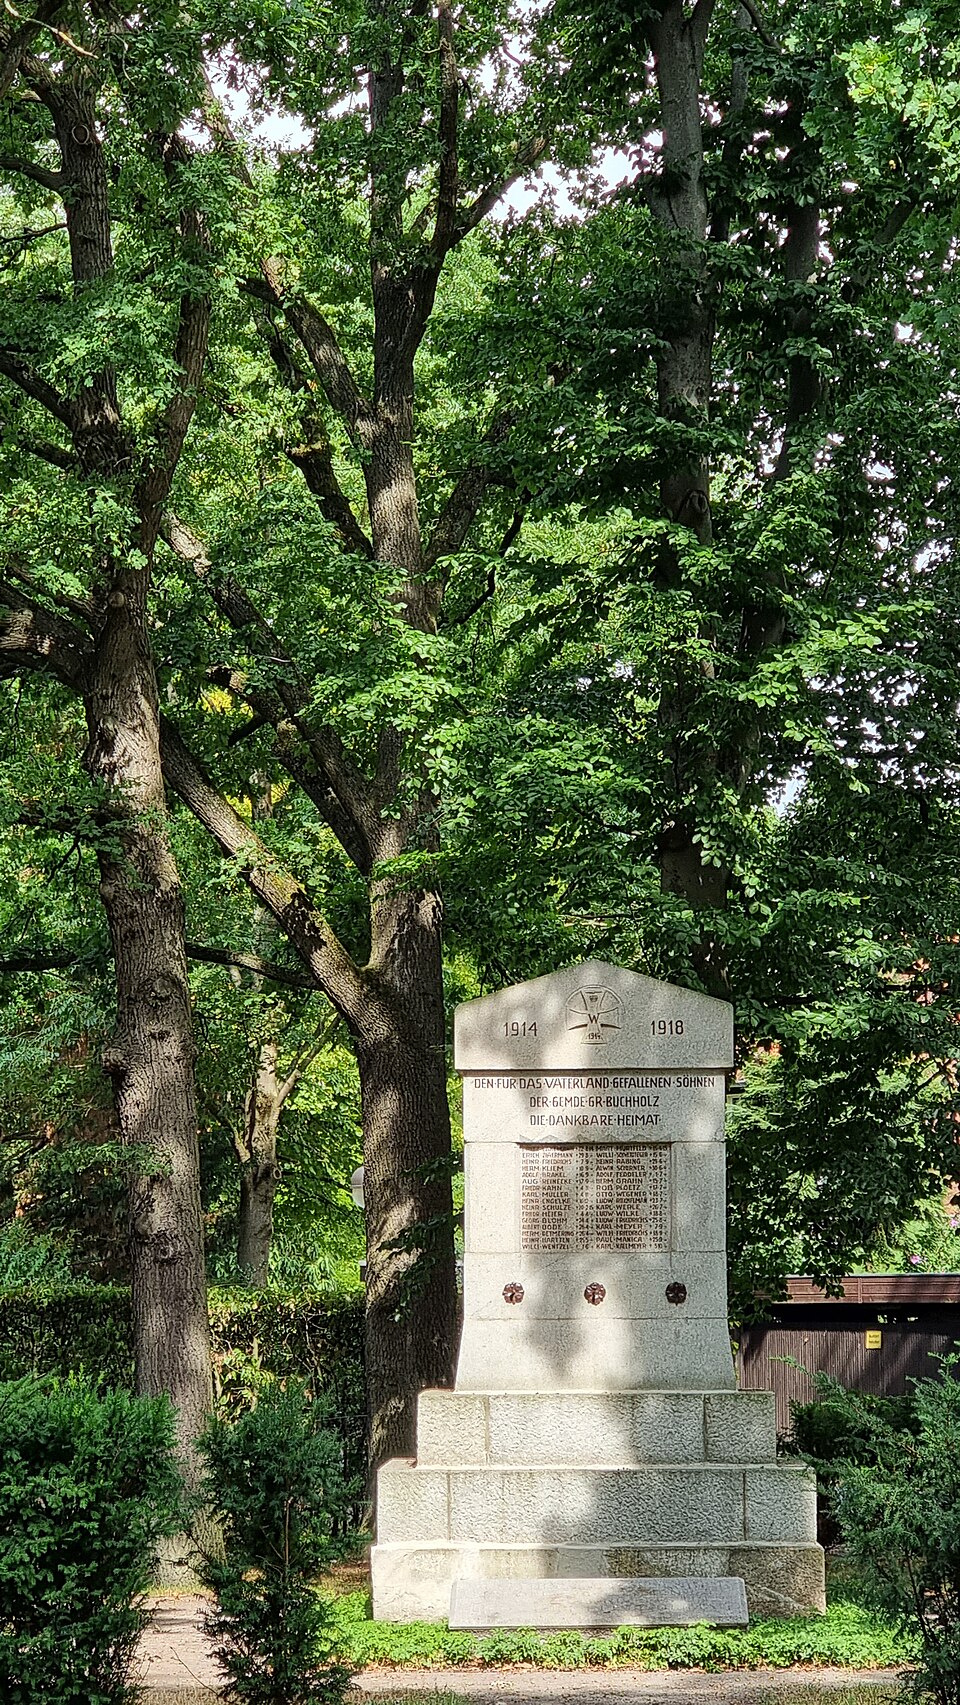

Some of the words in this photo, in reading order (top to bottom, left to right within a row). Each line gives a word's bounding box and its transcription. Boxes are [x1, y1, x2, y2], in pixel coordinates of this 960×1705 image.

[504, 1021, 538, 1037] 1914
[650, 1020, 684, 1036] 1918
[474, 1078, 494, 1089] DEN
[519, 1078, 542, 1089] DAS
[545, 1078, 610, 1089] VATERLAND
[612, 1077, 671, 1088] GEFALLENEN
[676, 1074, 715, 1088] SÖHNEN
[530, 1096, 548, 1108] DER
[588, 1096, 603, 1108] GR
[606, 1096, 660, 1108] BUCHHOLZ
[530, 1115, 545, 1126] DIE
[549, 1115, 614, 1126] DANKBARE
[617, 1115, 660, 1126] HEIMAT
